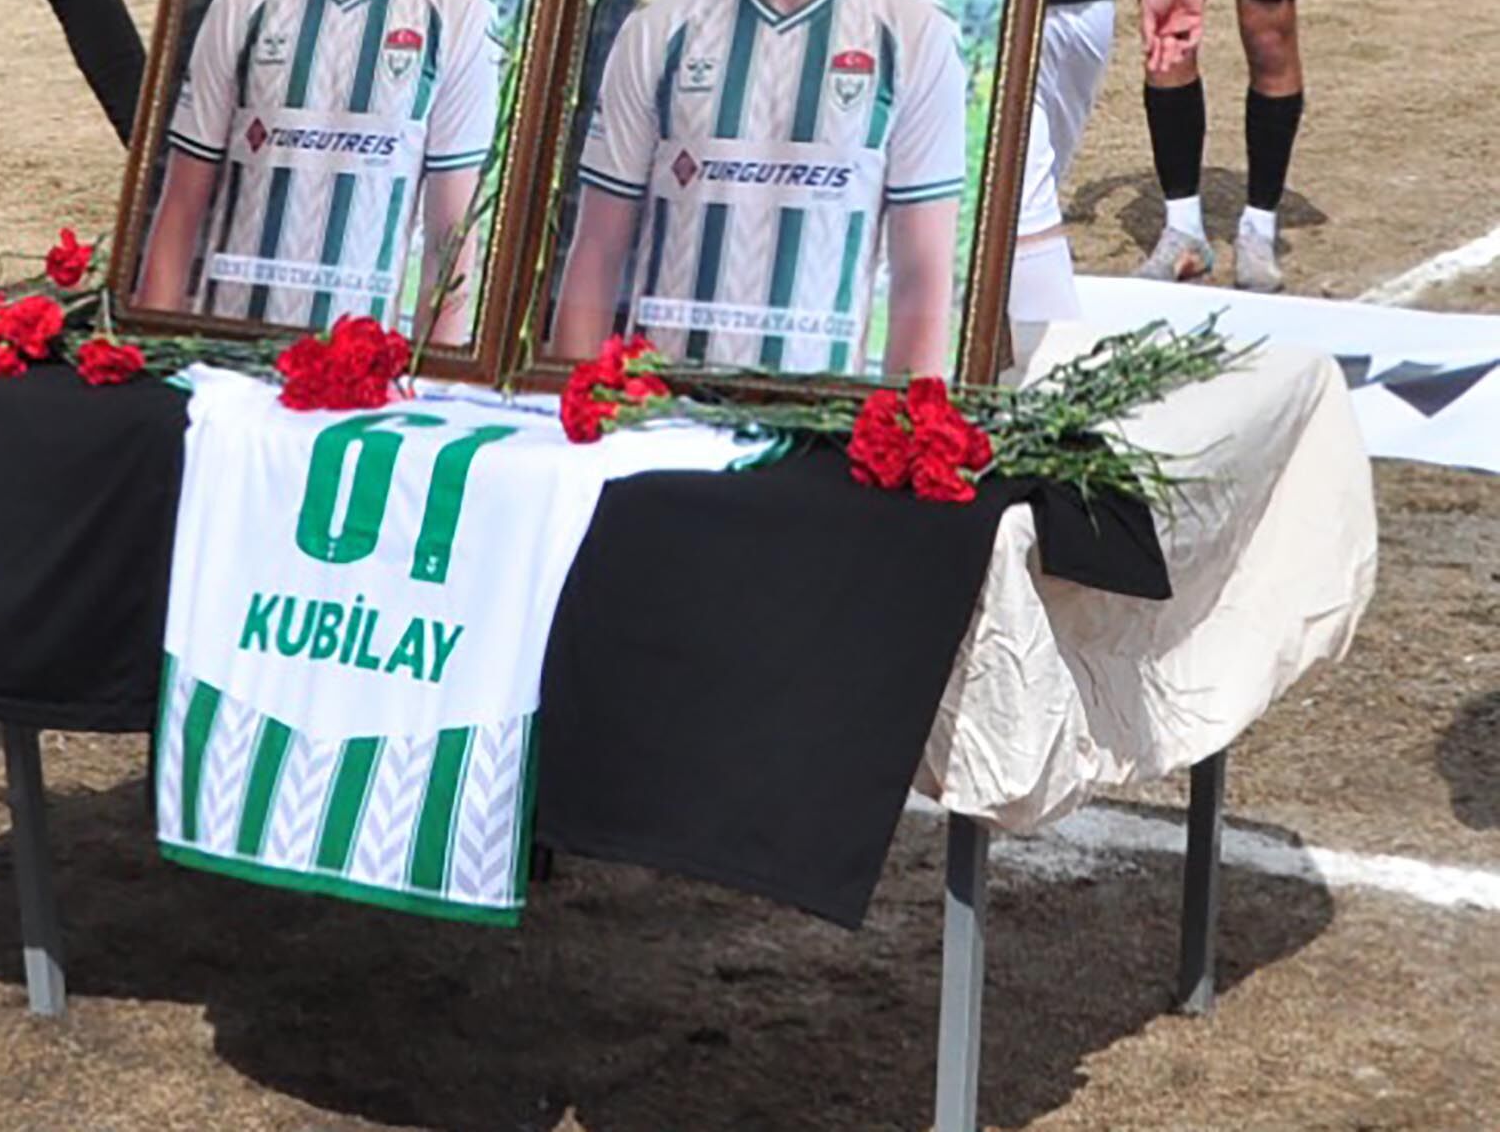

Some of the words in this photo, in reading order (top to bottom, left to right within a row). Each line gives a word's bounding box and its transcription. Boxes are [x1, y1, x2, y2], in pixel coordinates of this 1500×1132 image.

[266, 127, 399, 157] TURGUTREIS
[698, 159, 852, 188] TURGUTREIS
[238, 592, 465, 684] KUBİLAY
